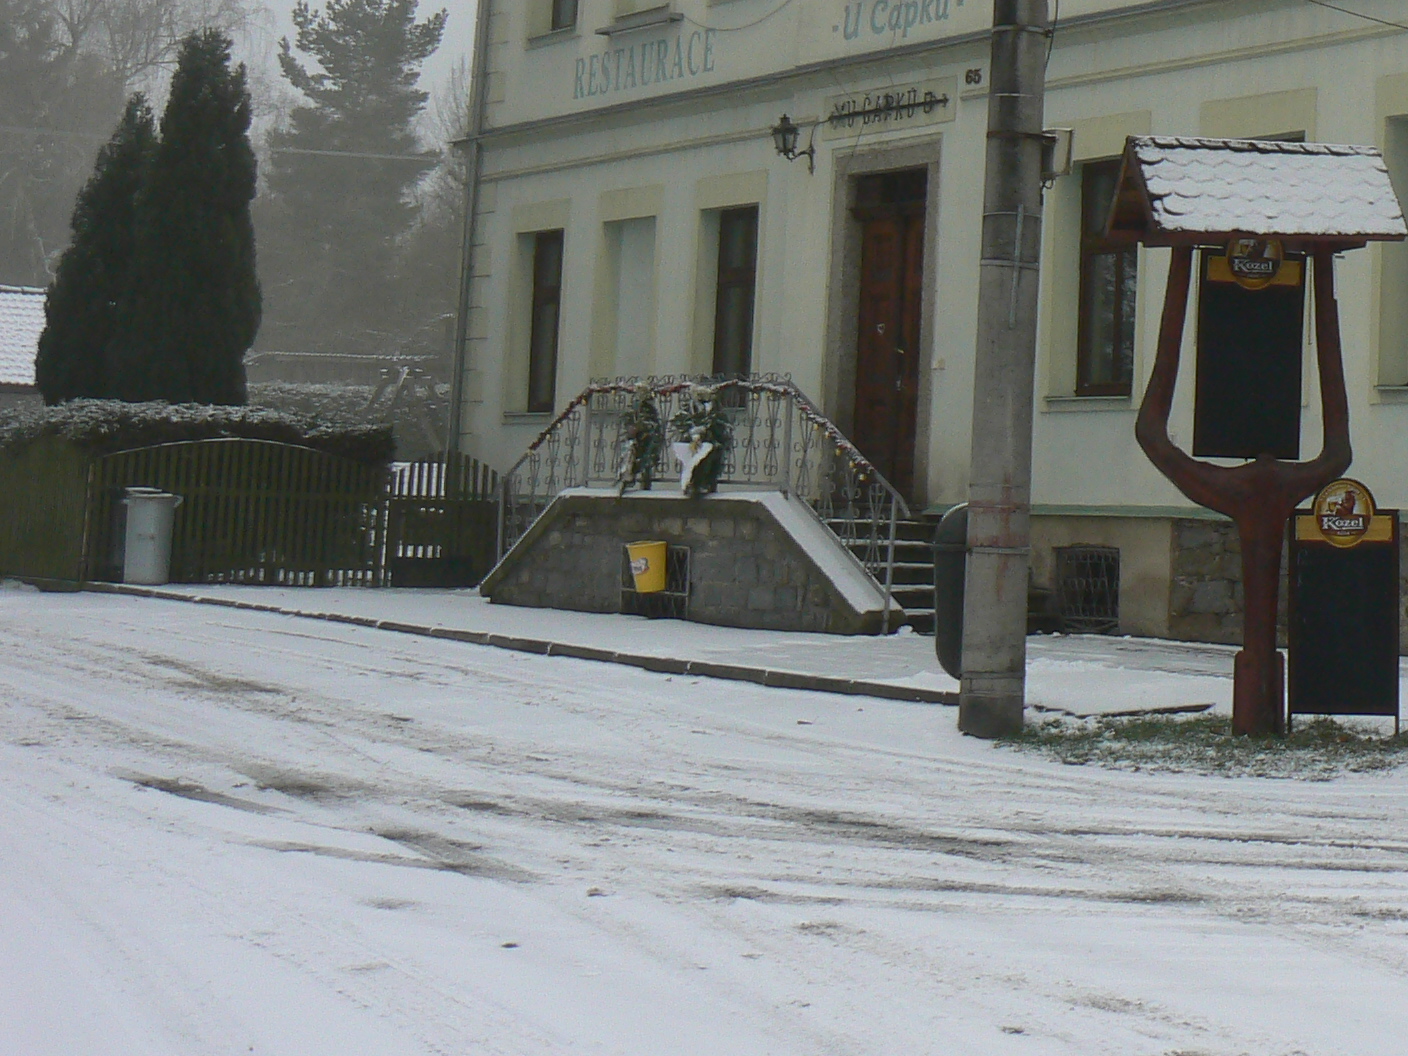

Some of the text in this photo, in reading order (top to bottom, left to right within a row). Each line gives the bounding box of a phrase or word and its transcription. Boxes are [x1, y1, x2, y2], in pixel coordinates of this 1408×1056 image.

[843, 2, 862, 41] U
[572, 28, 716, 100] RESTAURACE
[1233, 258, 1273, 273] Kozel
[1321, 517, 1364, 530] Kozel
